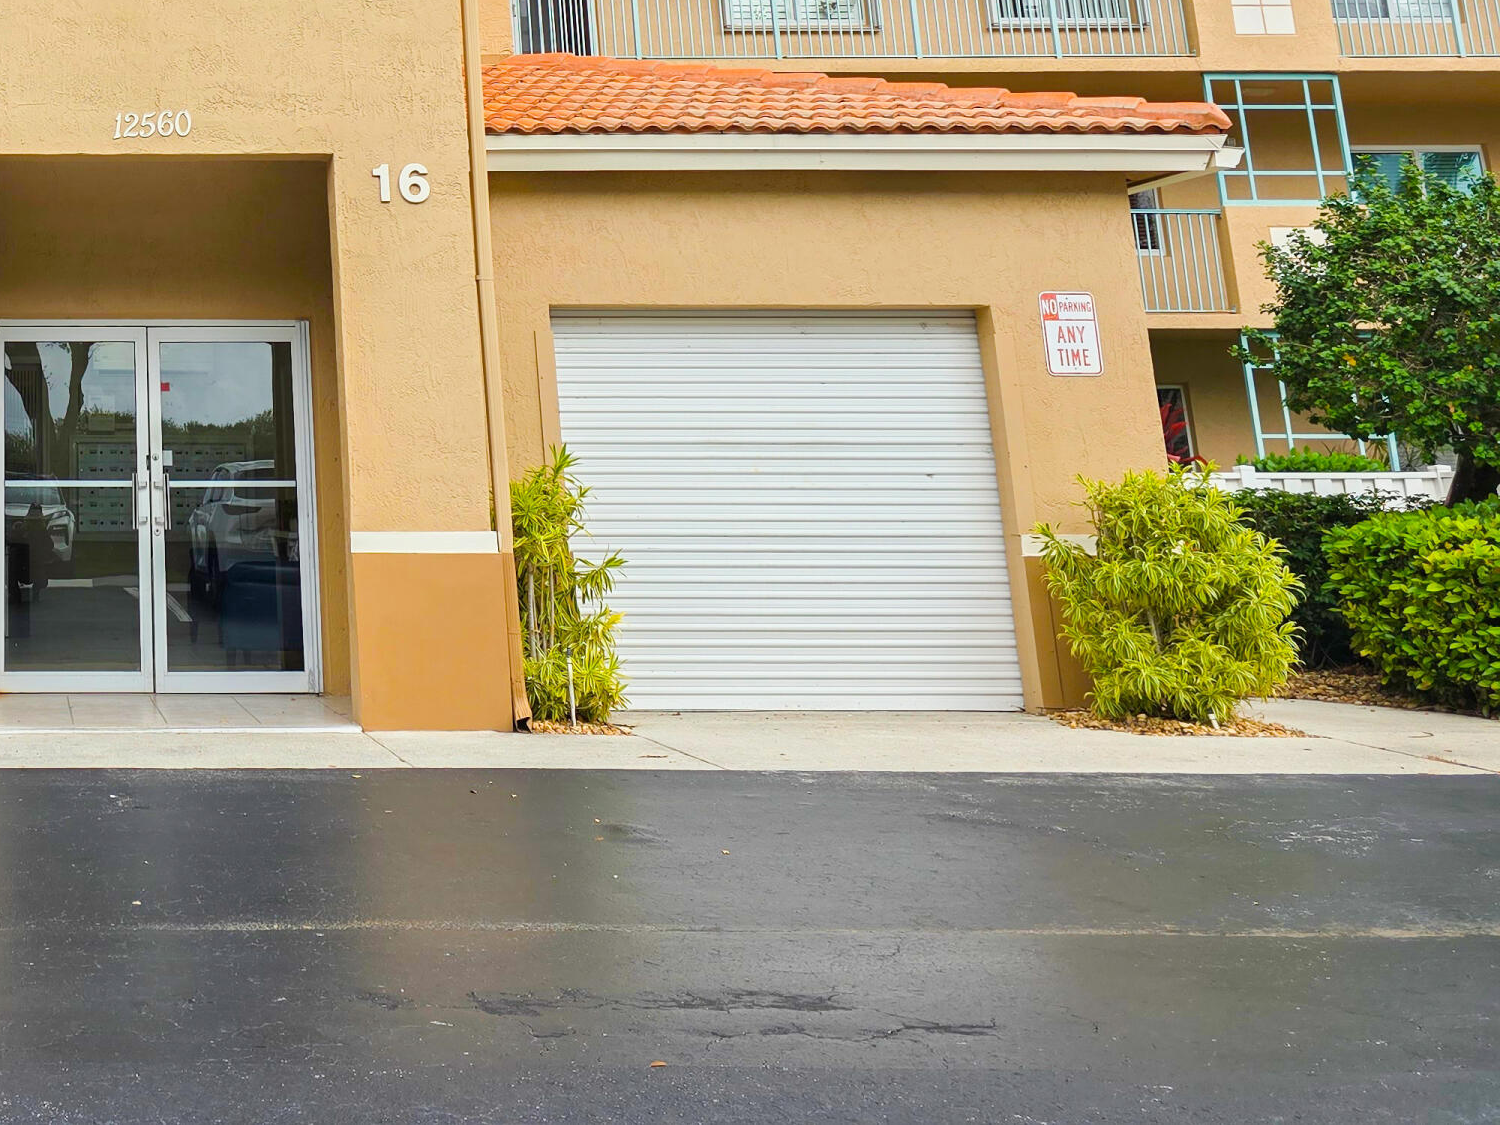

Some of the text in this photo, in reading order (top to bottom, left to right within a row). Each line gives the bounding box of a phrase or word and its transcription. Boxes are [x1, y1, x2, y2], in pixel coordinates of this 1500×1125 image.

[113, 109, 192, 140] 12560
[372, 163, 431, 204] 16
[1041, 299, 1092, 315] NO PARKING
[1057, 326, 1085, 344] ANY
[1057, 348, 1091, 366] TIME
